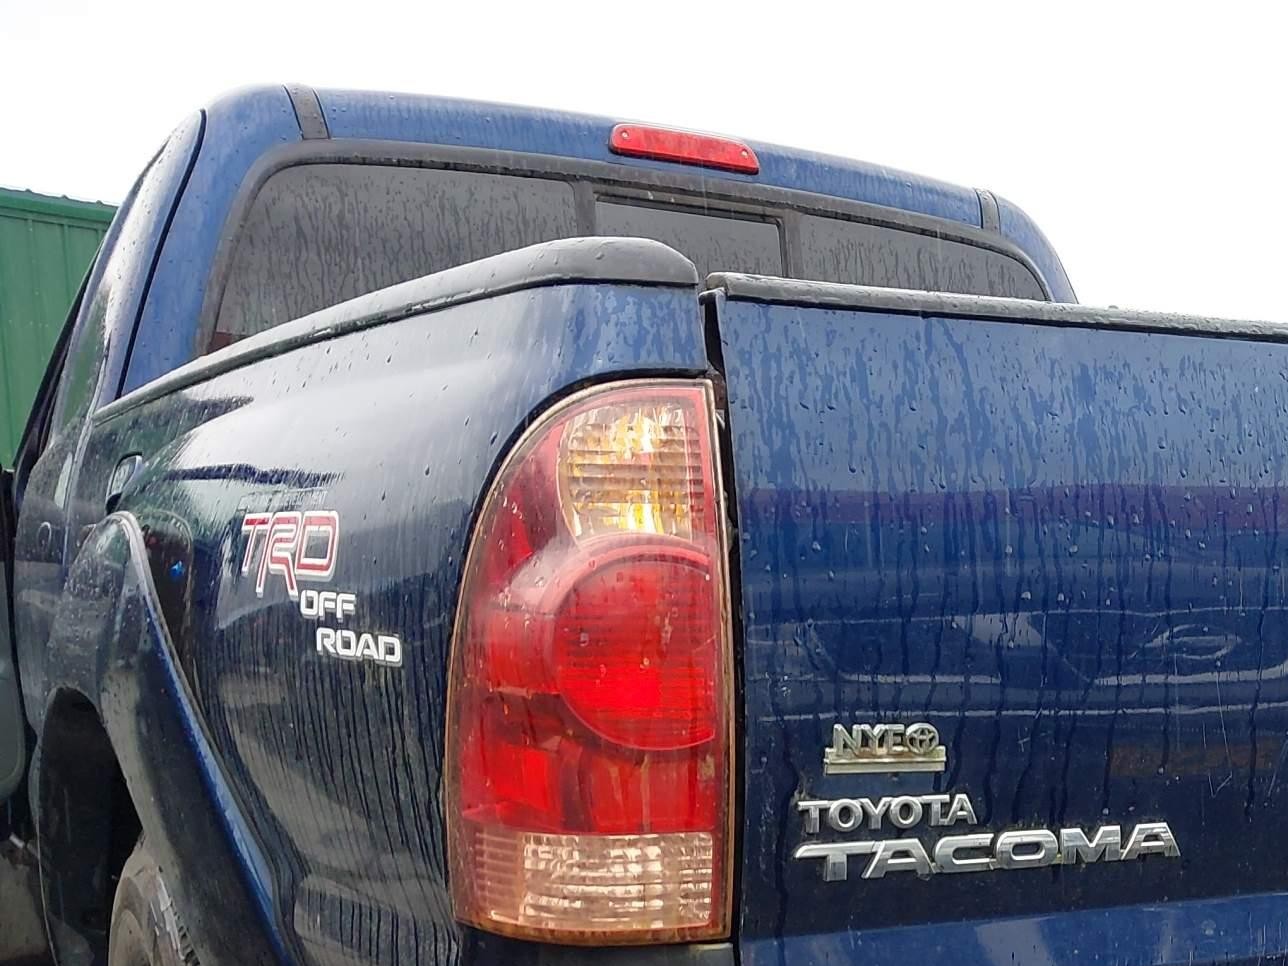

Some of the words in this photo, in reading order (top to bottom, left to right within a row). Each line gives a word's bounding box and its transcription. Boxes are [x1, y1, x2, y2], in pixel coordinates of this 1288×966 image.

[241, 510, 340, 600] TRD
[300, 589, 357, 622] OFF
[316, 627, 403, 667] ROAD
[797, 793, 978, 834] TOYOTA
[794, 821, 1182, 882] TACOMA
